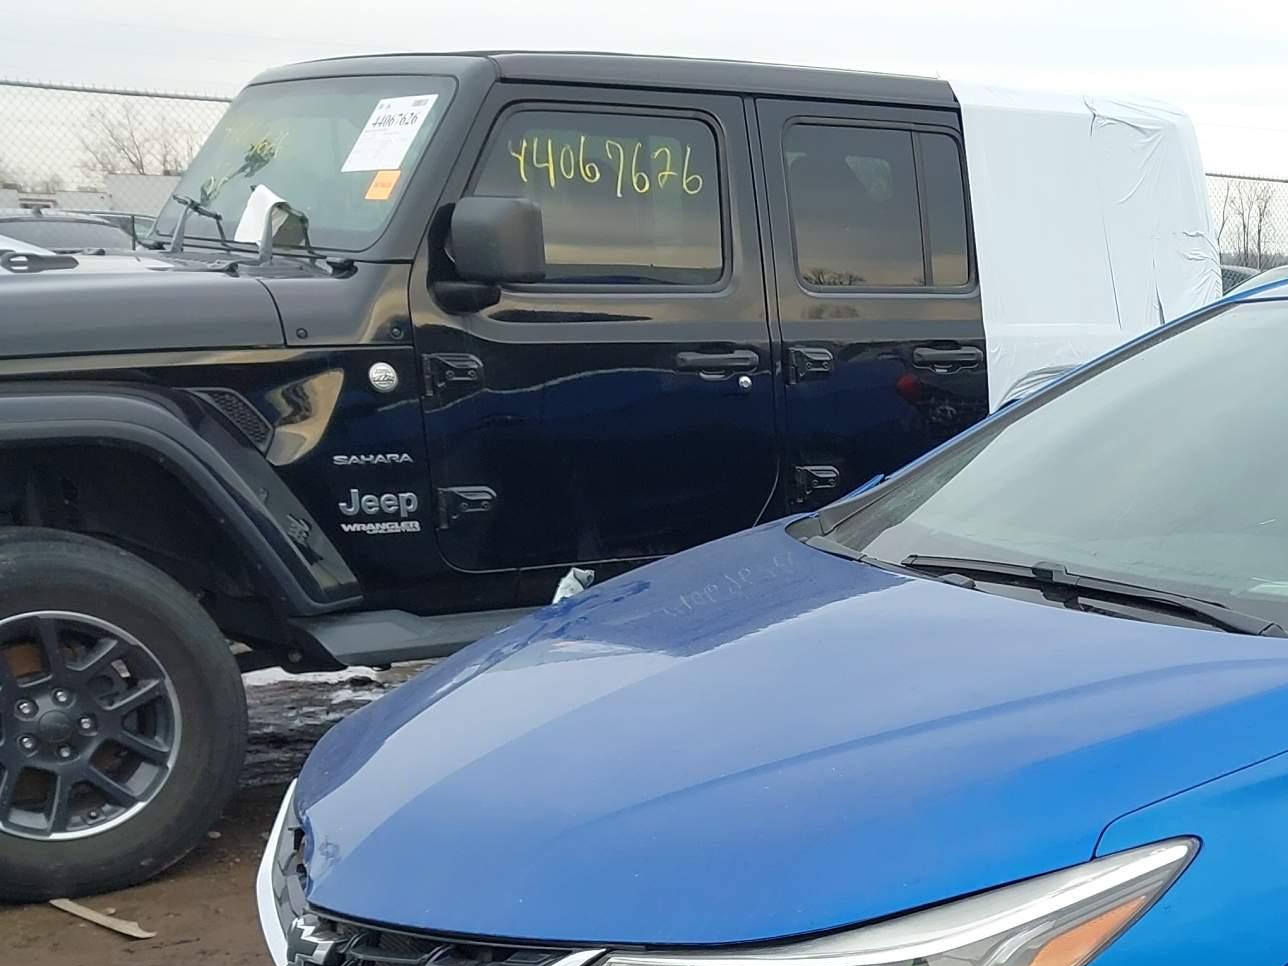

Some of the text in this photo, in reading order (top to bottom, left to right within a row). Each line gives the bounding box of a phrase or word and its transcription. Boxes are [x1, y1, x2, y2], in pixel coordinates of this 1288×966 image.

[333, 453, 414, 465] SAHARA
[338, 488, 419, 518] Jeep
[340, 520, 420, 532] WRANGLER
